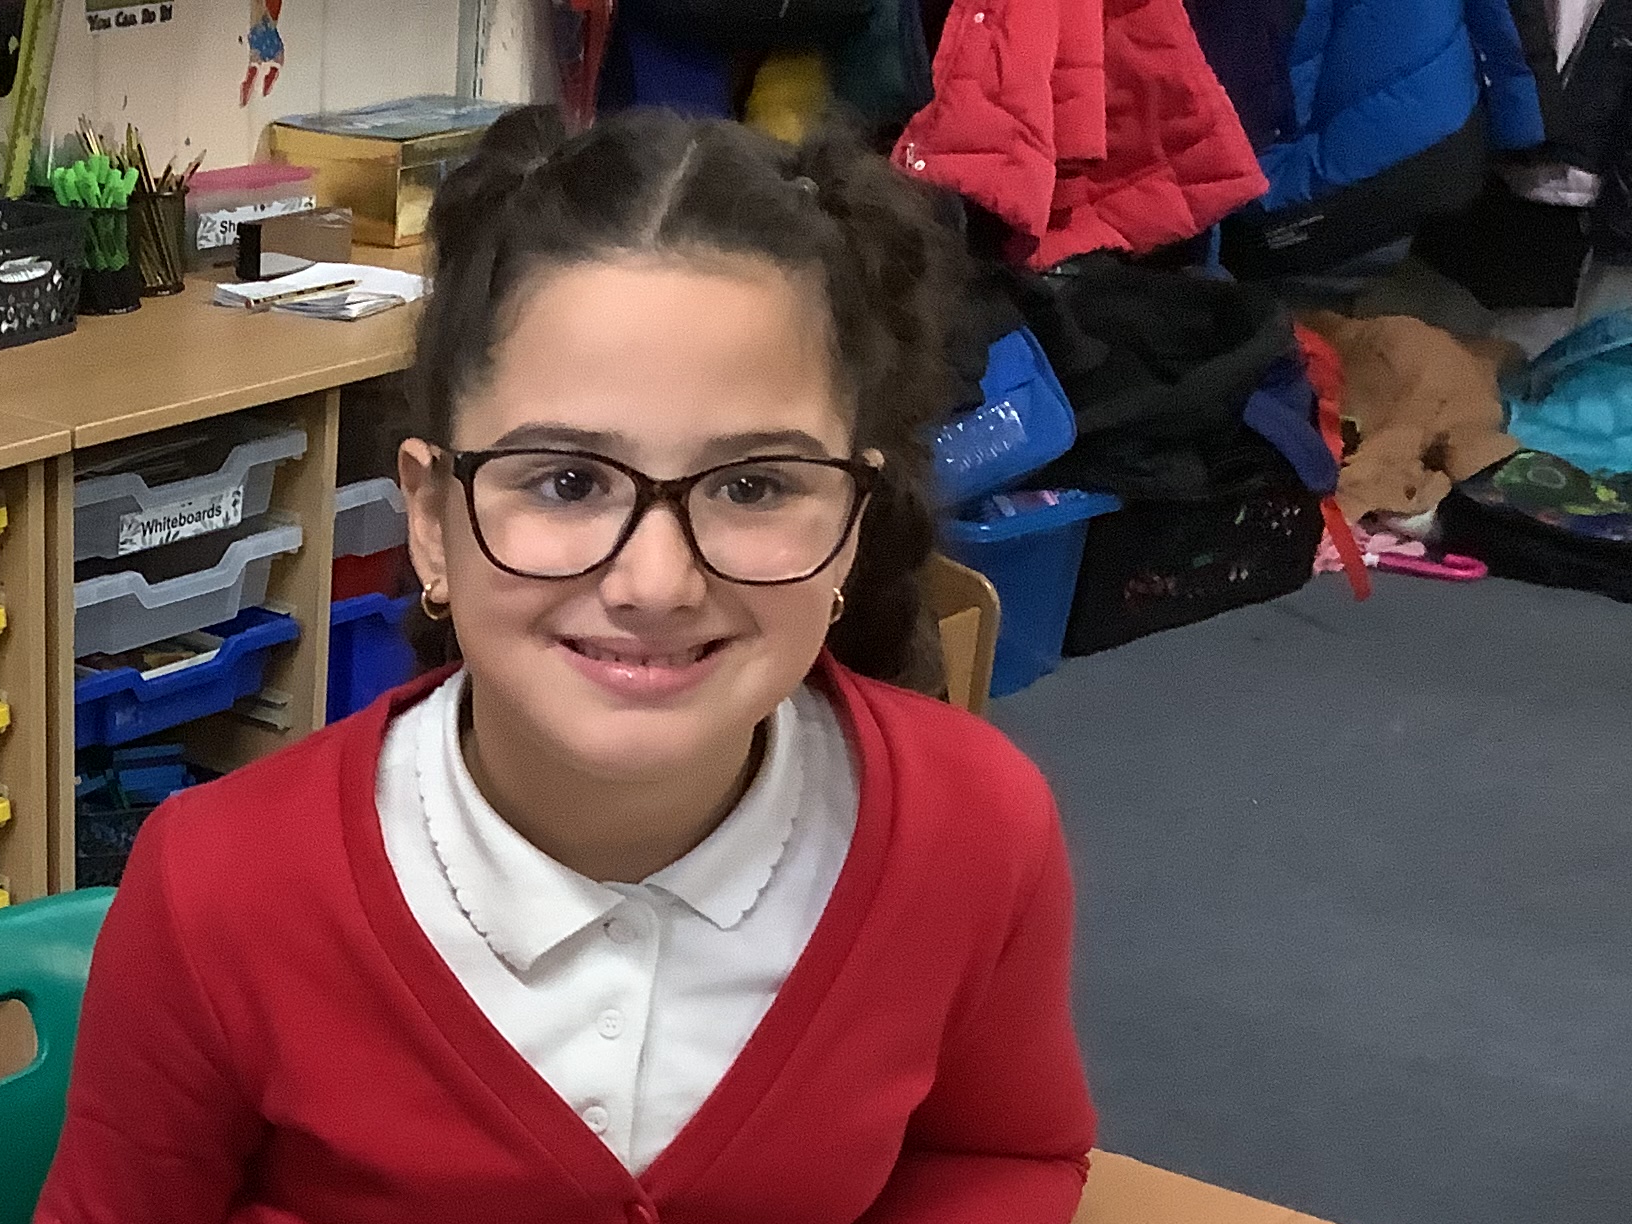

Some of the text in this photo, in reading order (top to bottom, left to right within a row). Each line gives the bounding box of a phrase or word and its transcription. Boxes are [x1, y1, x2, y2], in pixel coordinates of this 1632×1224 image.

[87, 14, 111, 32] You
[115, 11, 138, 27] Can
[141, 503, 222, 537] Whiteboards
